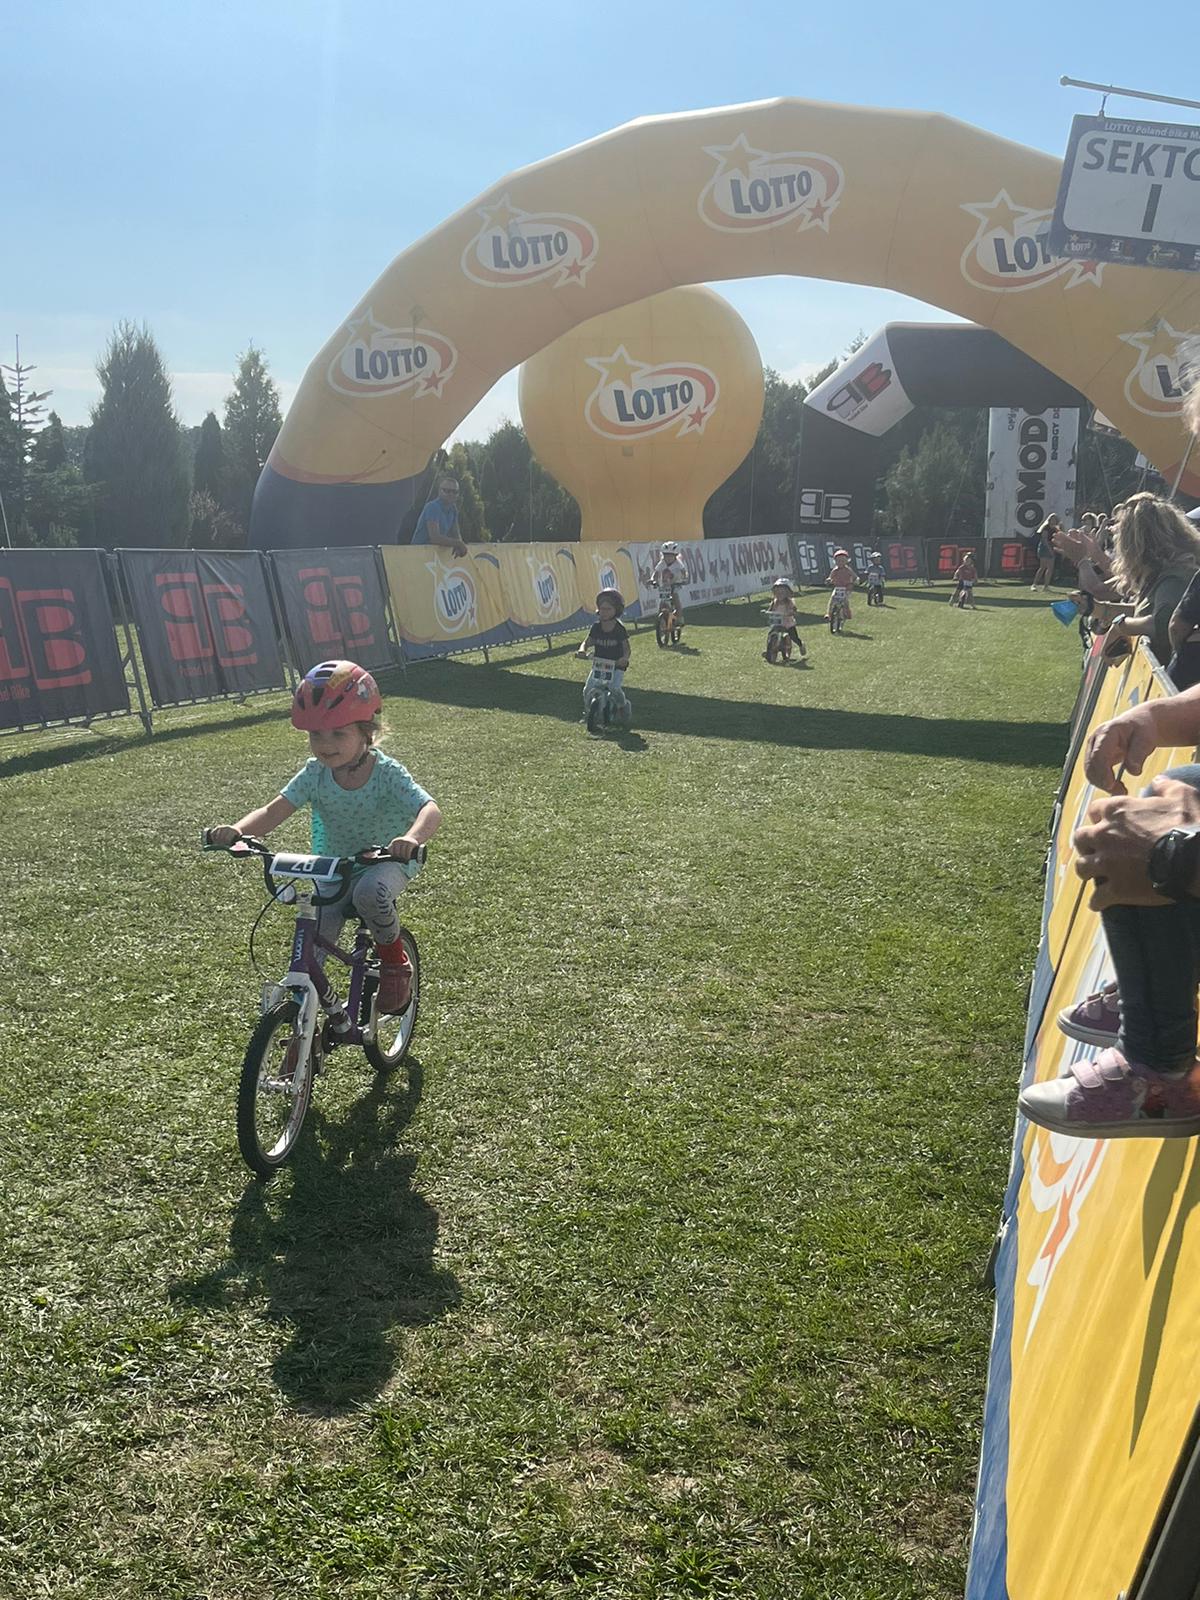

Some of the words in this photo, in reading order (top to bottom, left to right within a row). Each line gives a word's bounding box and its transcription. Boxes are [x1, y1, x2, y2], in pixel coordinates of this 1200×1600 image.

[1135, 126, 1167, 137] Poland
[730, 169, 812, 214] LOTTO
[491, 230, 569, 269] LOTTO
[993, 233, 1062, 273] LOT
[354, 345, 428, 380] LOTTO
[613, 379, 694, 422] LOTTO
[728, 540, 775, 577] KOMODO
[441, 581, 467, 617] LOTTO
[537, 575, 554, 604] LOTTO
